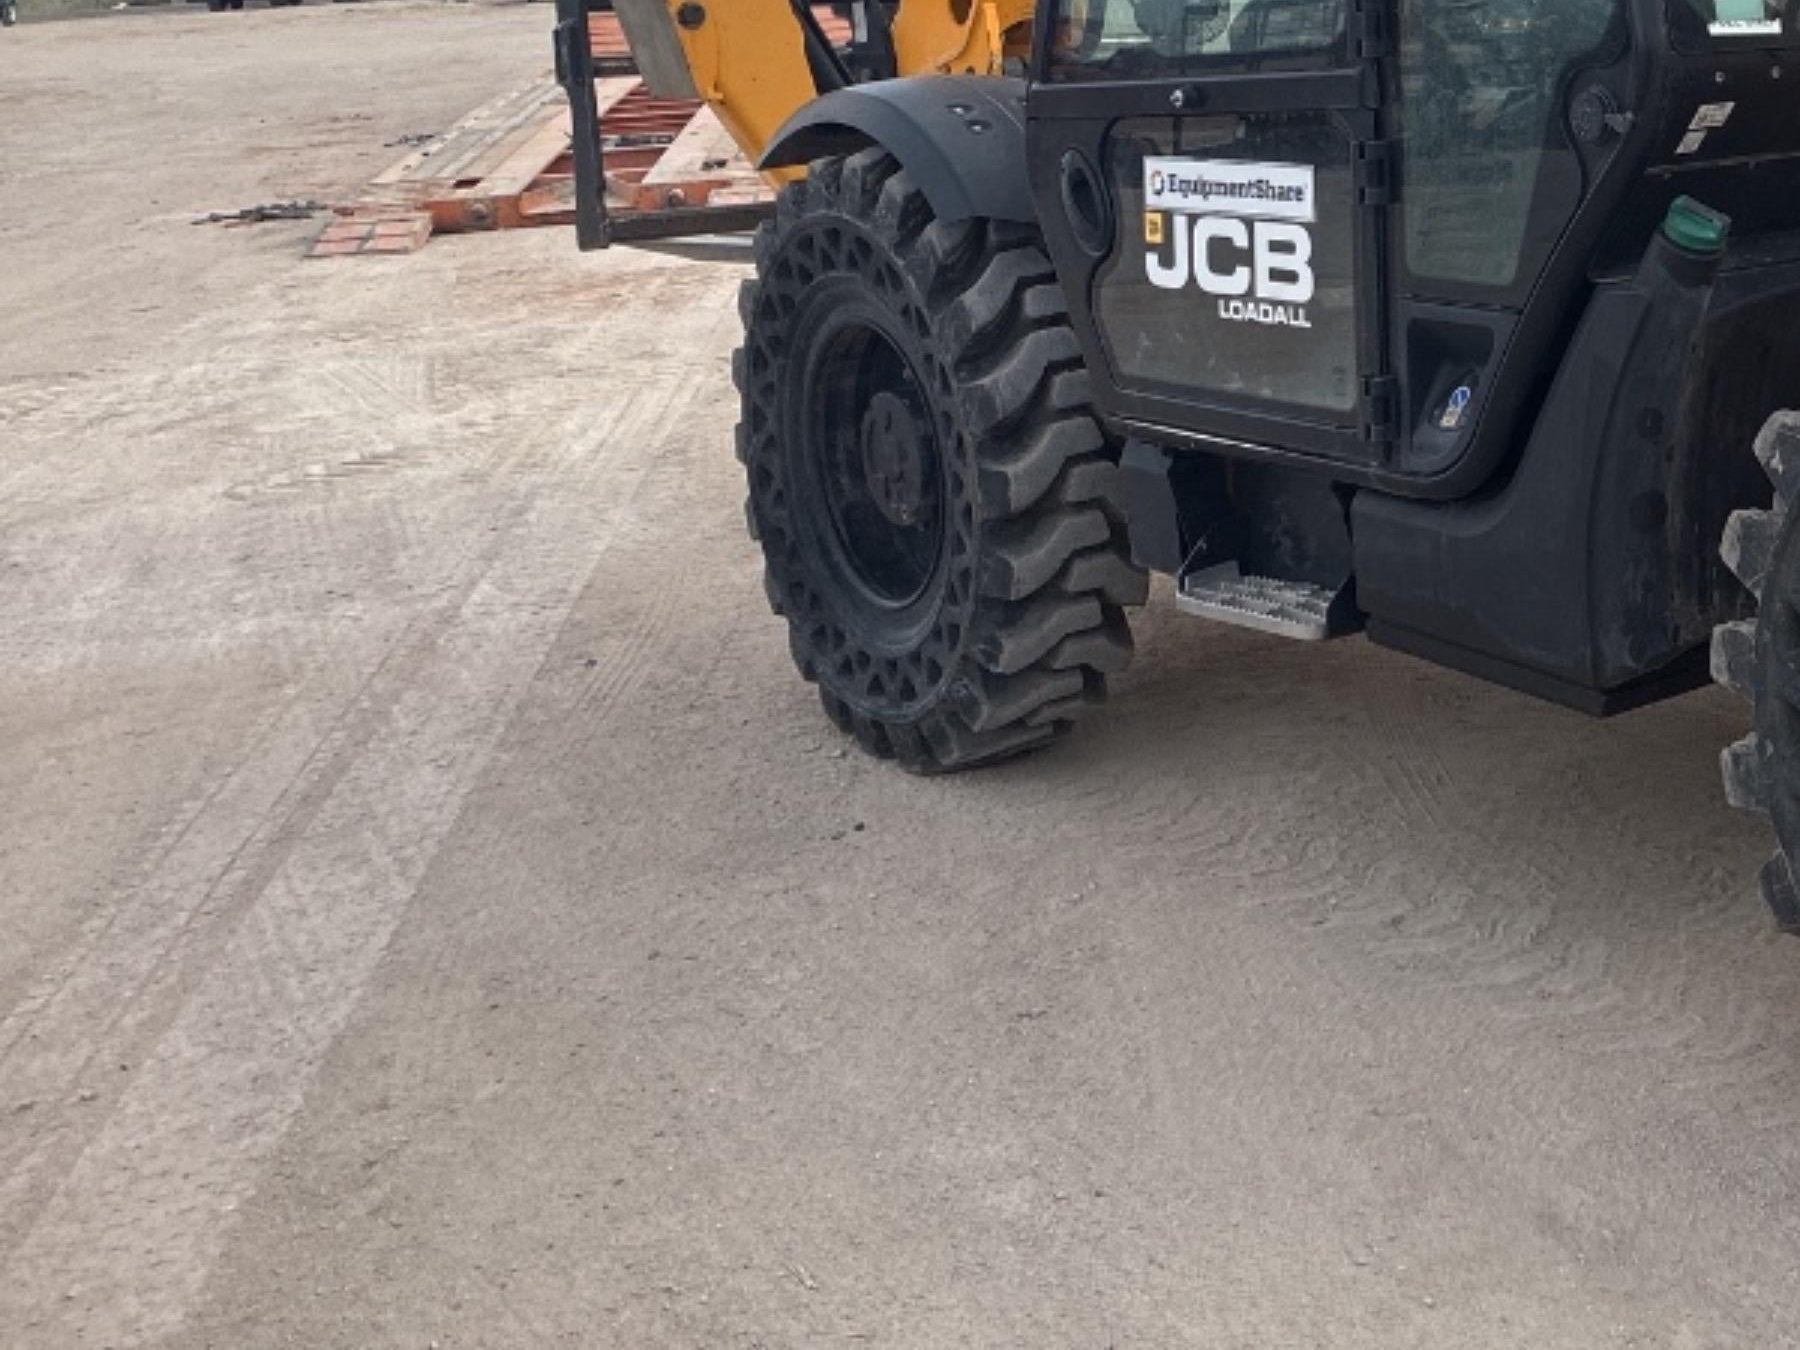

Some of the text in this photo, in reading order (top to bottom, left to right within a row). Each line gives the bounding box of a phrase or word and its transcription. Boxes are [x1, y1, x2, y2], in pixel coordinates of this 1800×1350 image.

[1167, 173, 1305, 201] EquipmentShare
[1144, 214, 1315, 303] JCB
[1218, 299, 1313, 328] LOADALL
